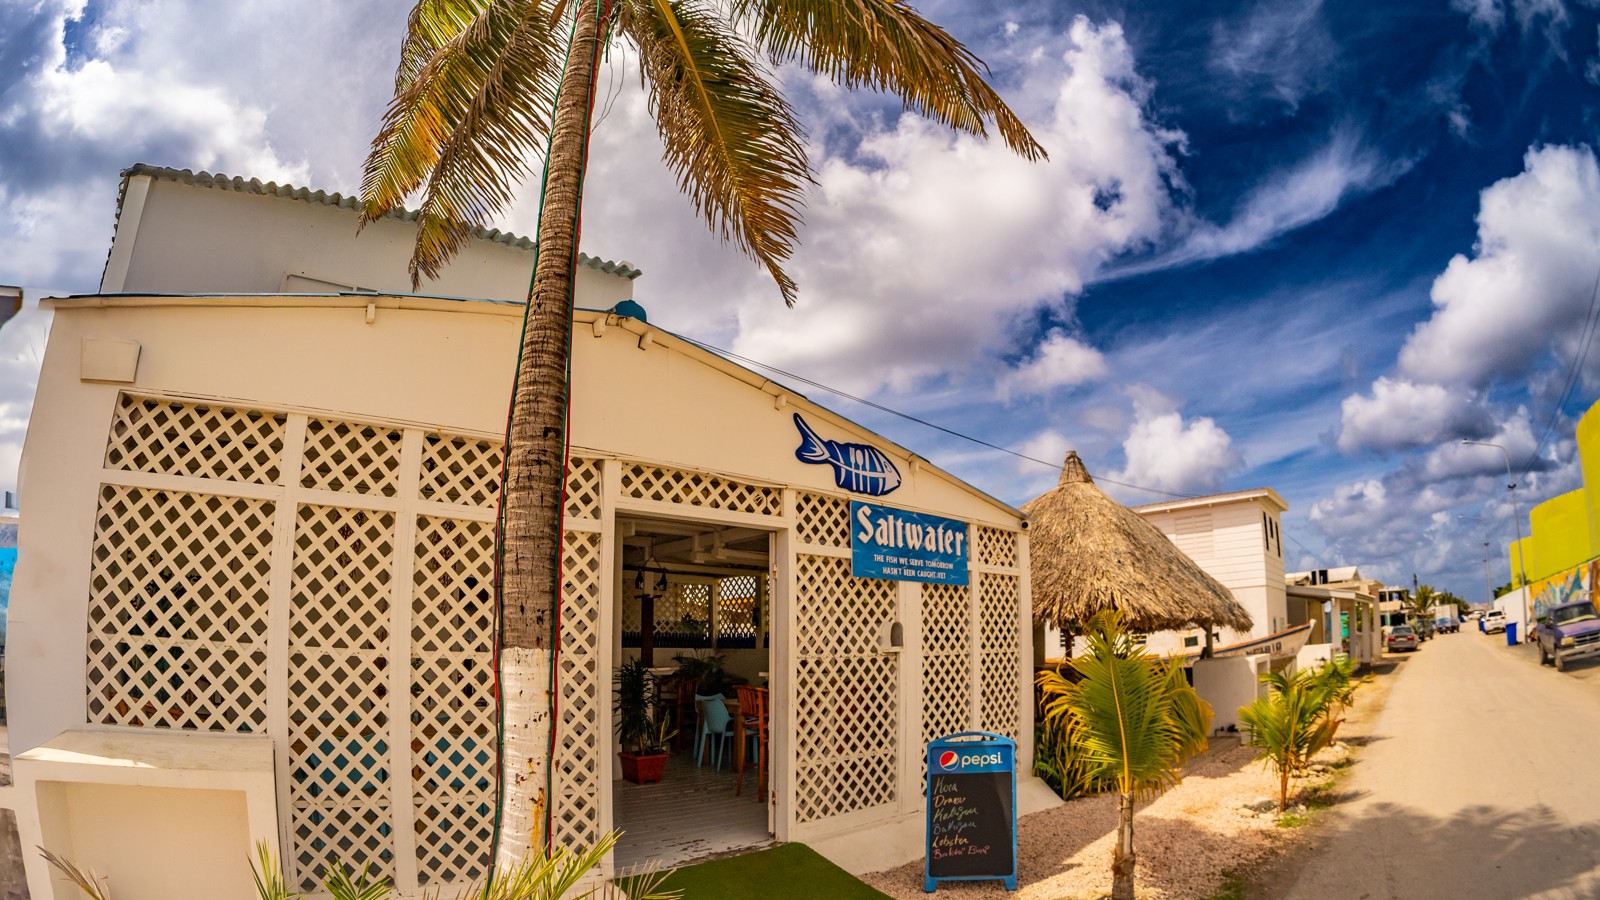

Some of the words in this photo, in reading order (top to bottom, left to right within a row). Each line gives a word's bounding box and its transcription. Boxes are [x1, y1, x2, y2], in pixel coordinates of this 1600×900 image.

[857, 505, 964, 556] Saltwater
[874, 554, 884, 563] THE
[886, 555, 898, 564] FISH
[899, 557, 908, 566] WE
[909, 558, 924, 567] SERVE
[925, 560, 954, 570] TOMORROW
[882, 567, 902, 575] HASN'T
[903, 569, 916, 577] BEEN
[961, 752, 1002, 768] pepsi
[932, 835, 969, 848] Lobster
